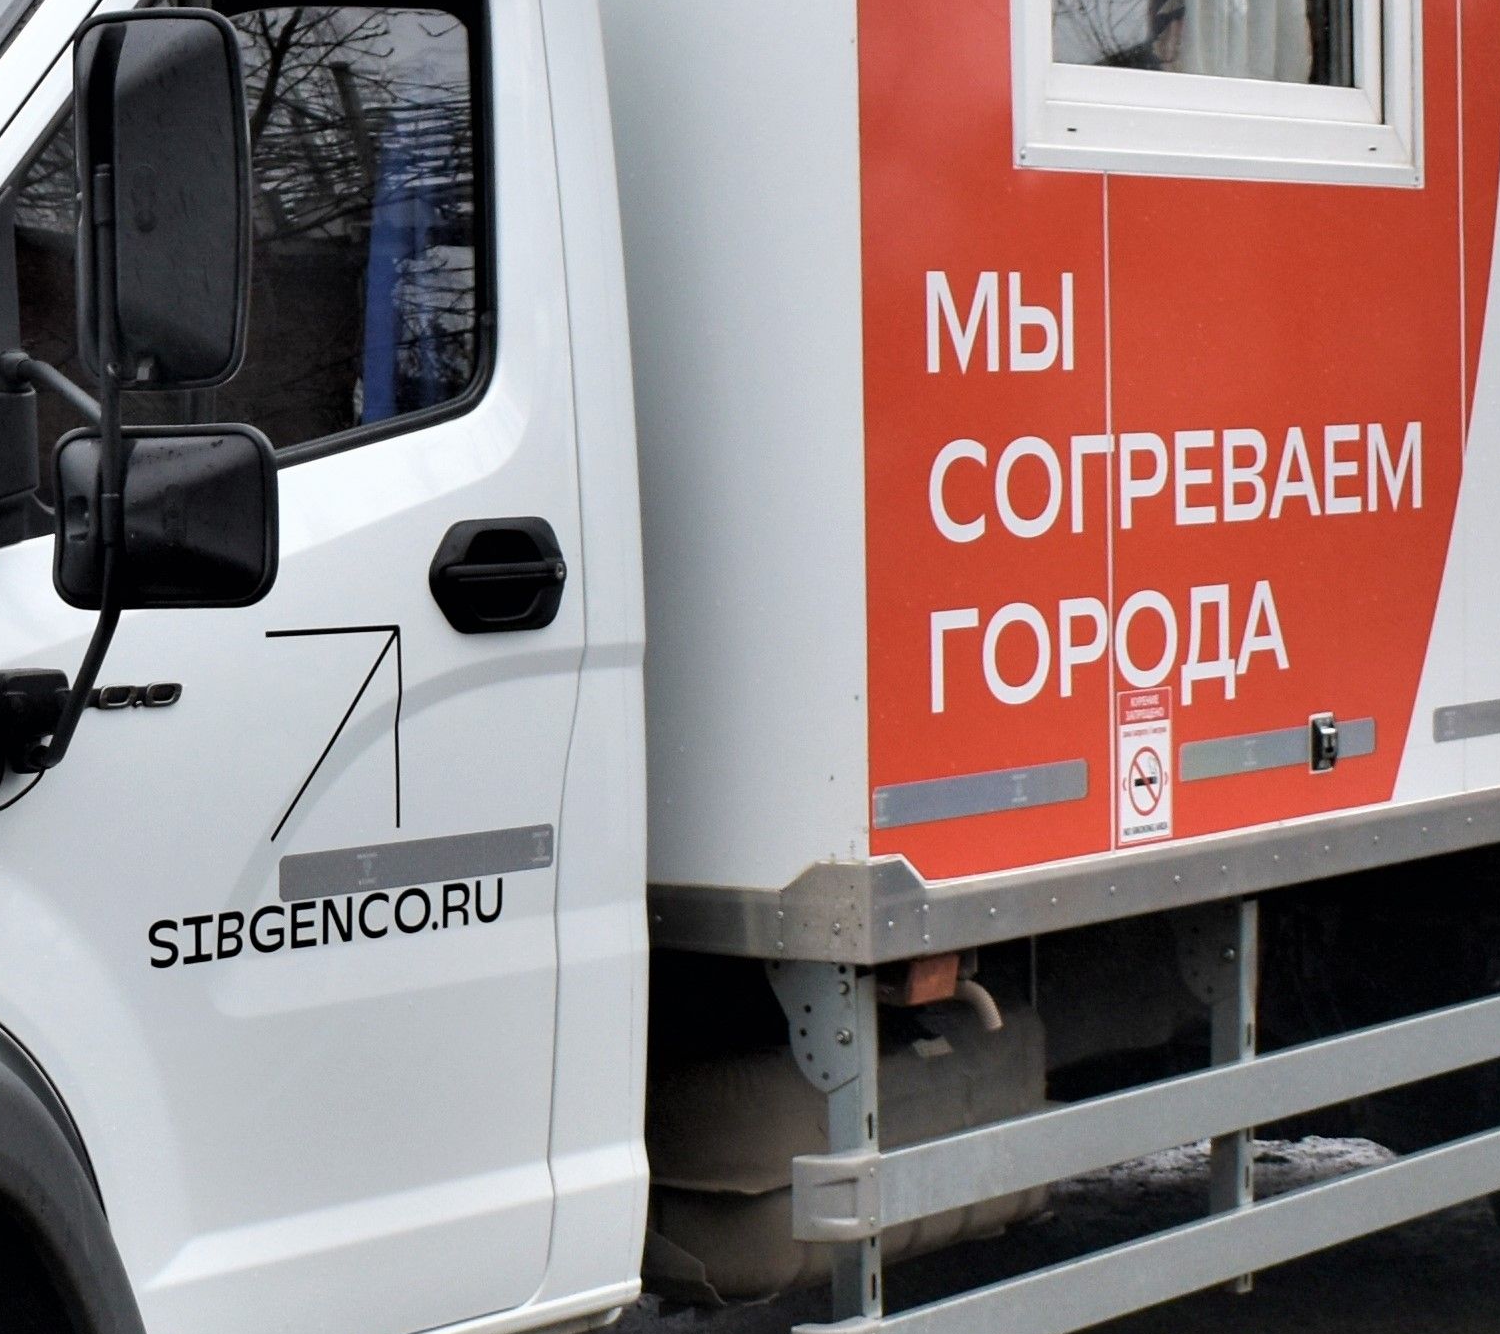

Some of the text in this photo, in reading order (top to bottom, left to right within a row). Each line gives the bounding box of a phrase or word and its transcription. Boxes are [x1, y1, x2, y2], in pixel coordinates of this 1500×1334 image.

[926, 270, 1074, 375] МЫ
[928, 421, 1424, 543] СОГРЕВАЕМ
[930, 579, 1290, 714] ГОРОДА
[147, 877, 504, 969] SIBGENCO.RU
